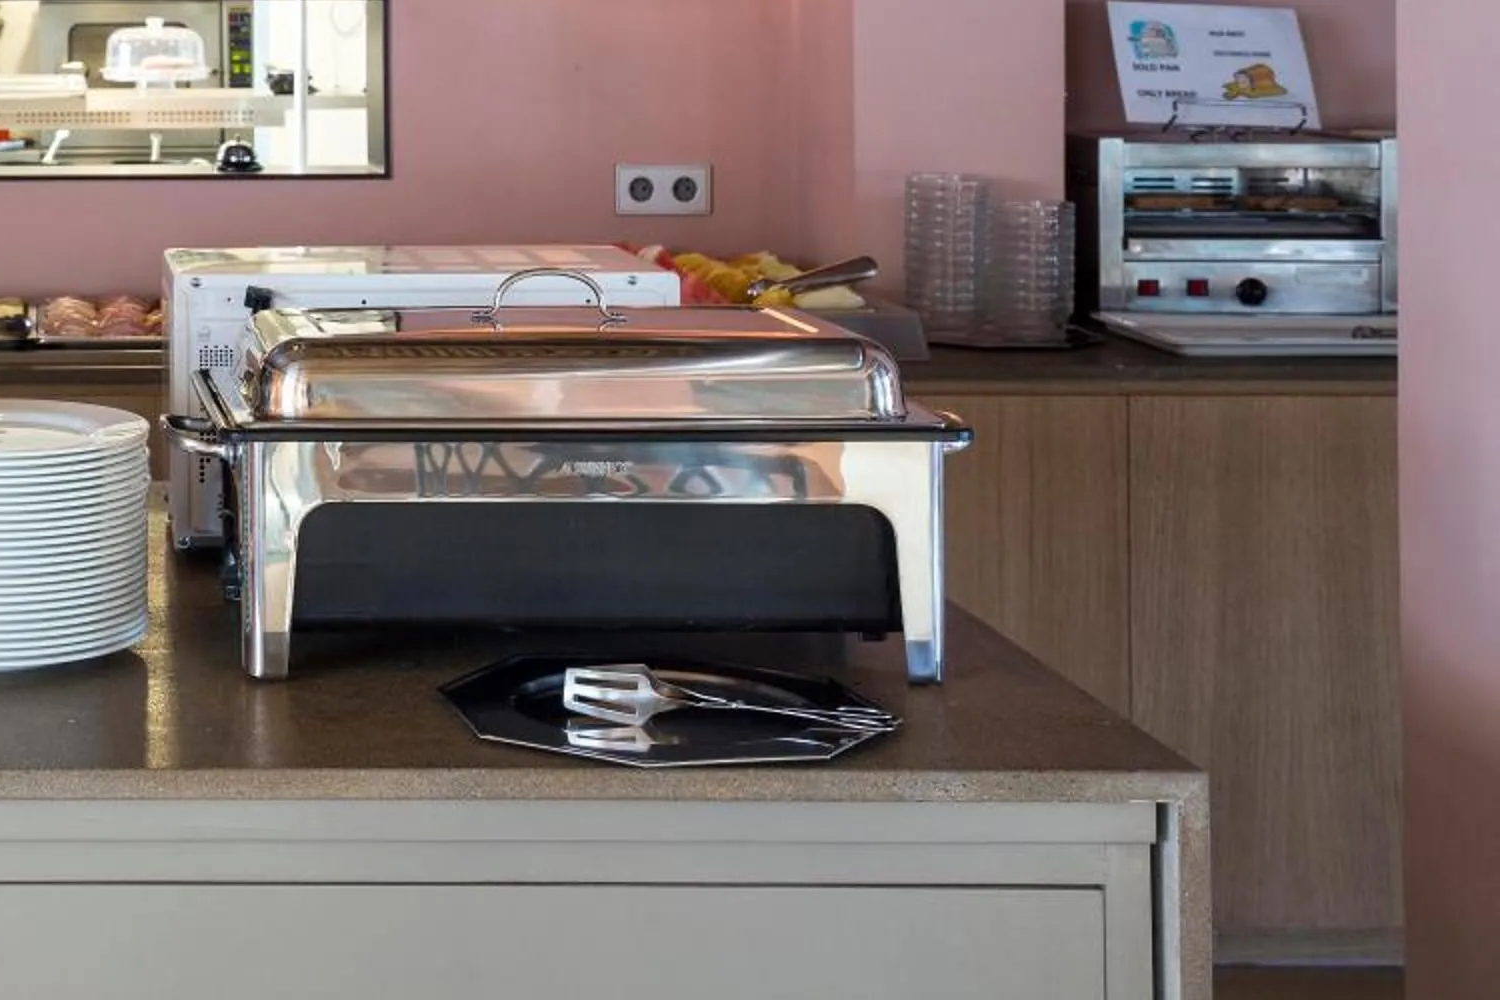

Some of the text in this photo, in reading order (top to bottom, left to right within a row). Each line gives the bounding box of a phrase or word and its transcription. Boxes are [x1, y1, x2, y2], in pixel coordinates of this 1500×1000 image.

[1132, 62, 1158, 71] SOLO
[1137, 89, 1197, 98] ONLY BREAD
